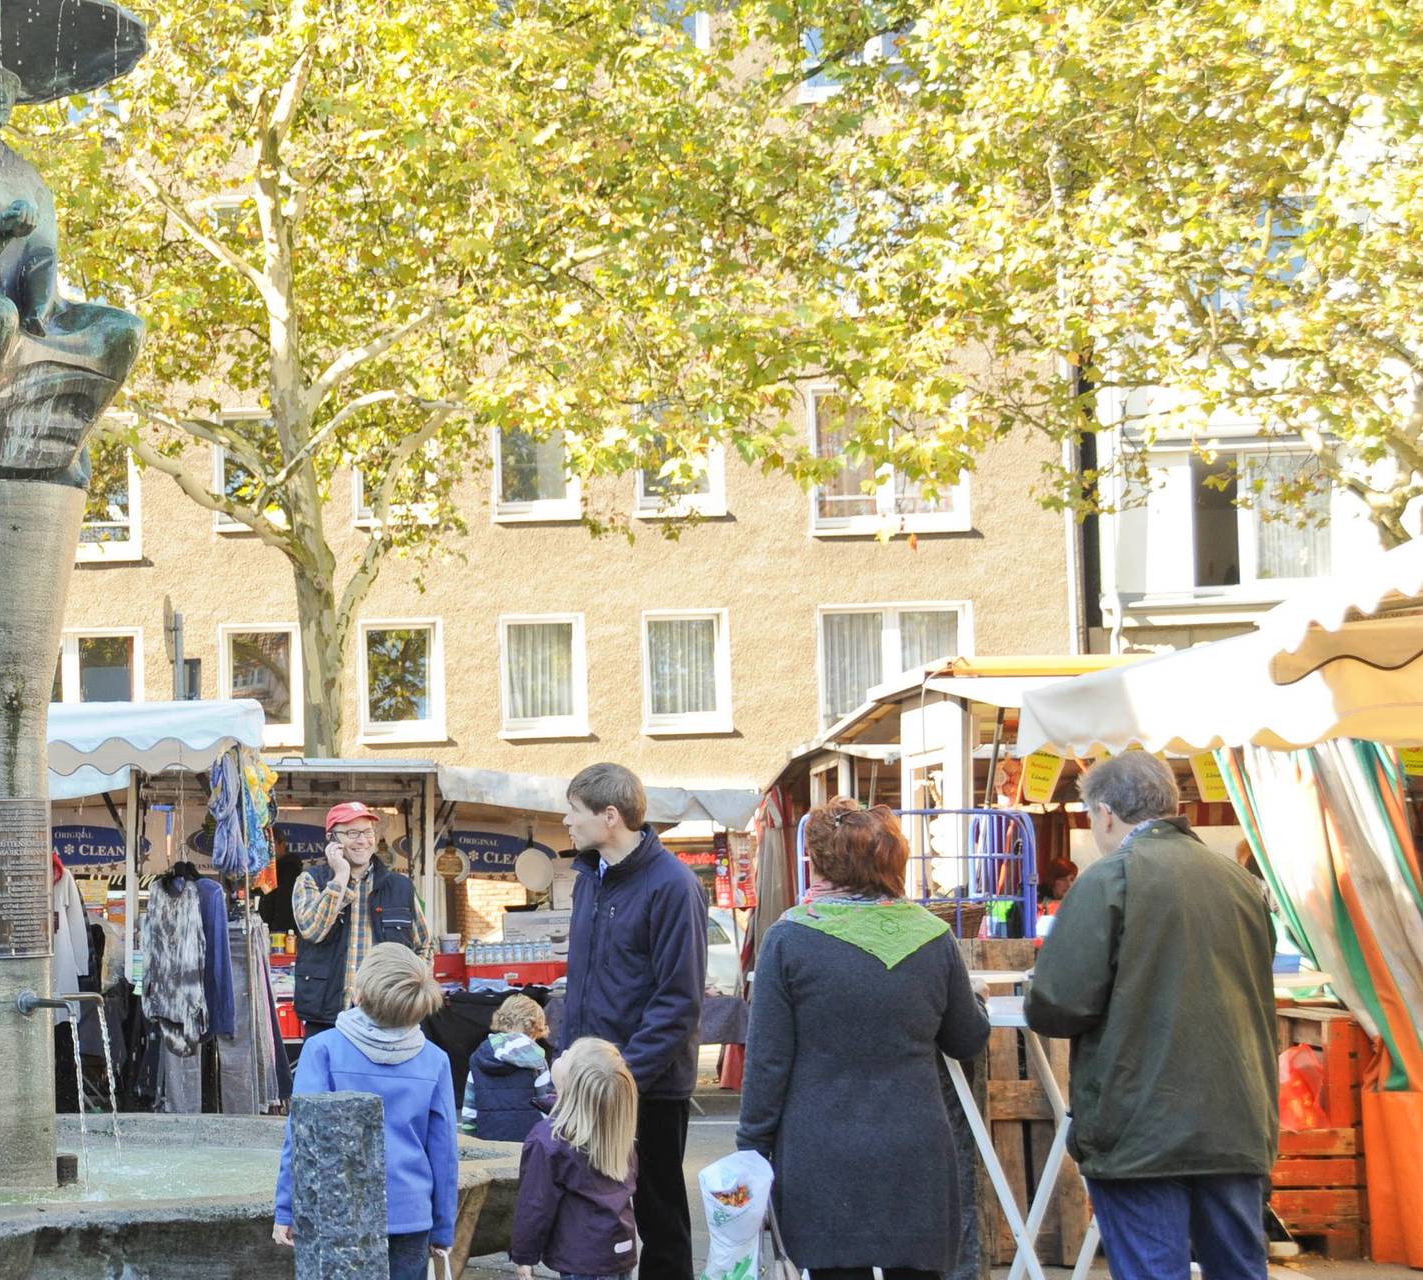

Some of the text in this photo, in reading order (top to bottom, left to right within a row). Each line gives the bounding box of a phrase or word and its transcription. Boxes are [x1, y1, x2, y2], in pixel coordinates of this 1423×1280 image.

[285, 841, 325, 854] LEAN
[459, 836, 499, 848] ORIGINAL
[78, 843, 126, 857] CLEAN
